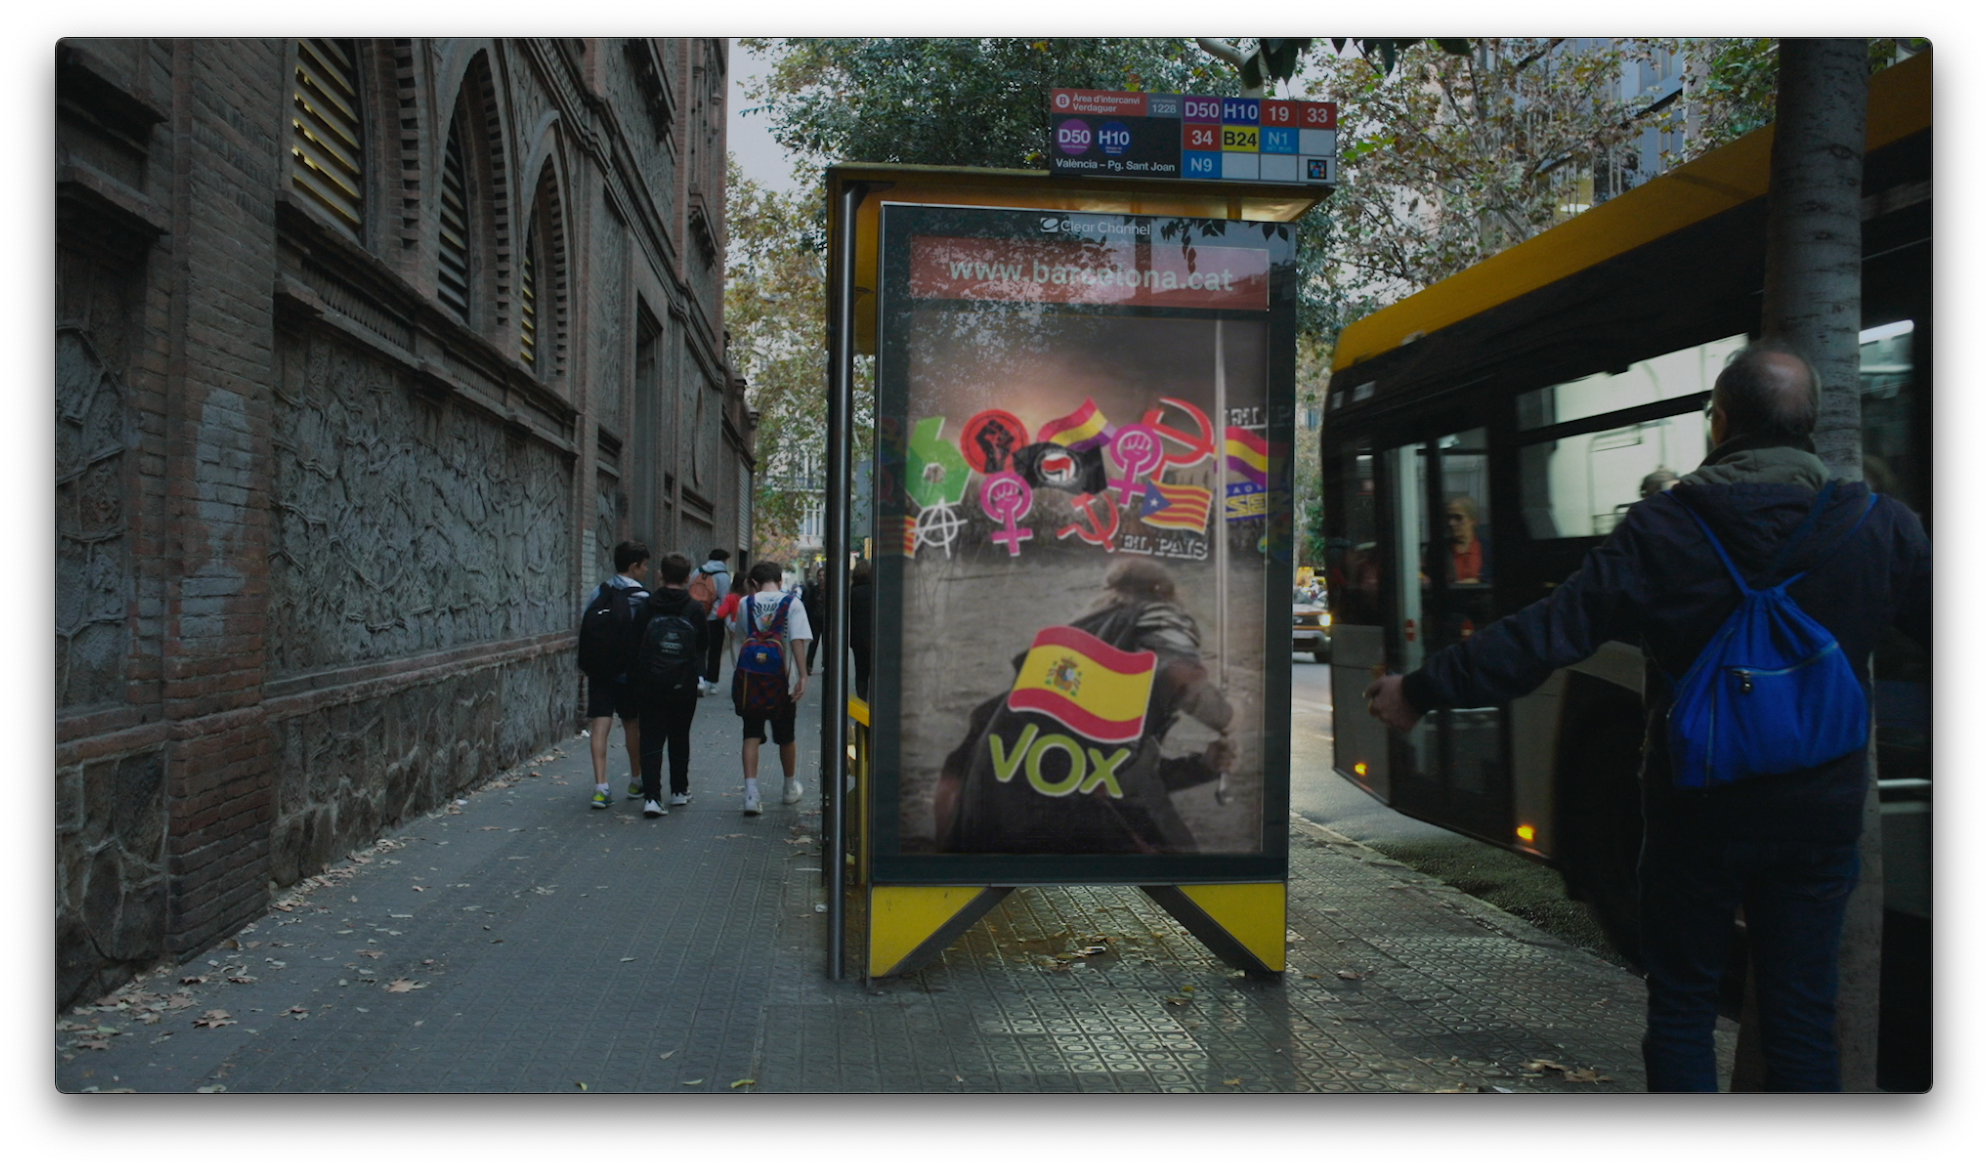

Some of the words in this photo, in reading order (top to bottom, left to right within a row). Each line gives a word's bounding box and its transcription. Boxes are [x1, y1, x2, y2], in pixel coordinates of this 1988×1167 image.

[1073, 93, 1092, 103] Àrea
[1094, 94, 1140, 104] d'intercanvi
[1073, 103, 1117, 113] Verdaguer
[1152, 104, 1177, 113] 1228
[1185, 102, 1219, 118] D50
[1224, 103, 1258, 120] H10
[1269, 106, 1289, 122] 19
[1307, 108, 1328, 123] 33
[1058, 129, 1091, 144] D50
[1098, 131, 1130, 146] H10
[1192, 130, 1213, 145] 34
[1224, 131, 1257, 147] B24
[1268, 132, 1288, 145] N1
[1056, 158, 1098, 169] València
[1107, 160, 1123, 172] Pg.
[1126, 161, 1149, 171] Sant
[1150, 162, 1175, 172] Joan
[1191, 158, 1213, 172] N9
[1060, 219, 1095, 233] Clear
[1097, 221, 1151, 234] Channel
[949, 259, 1234, 292] www.barcelona.cat
[990, 722, 1131, 799] VOX
